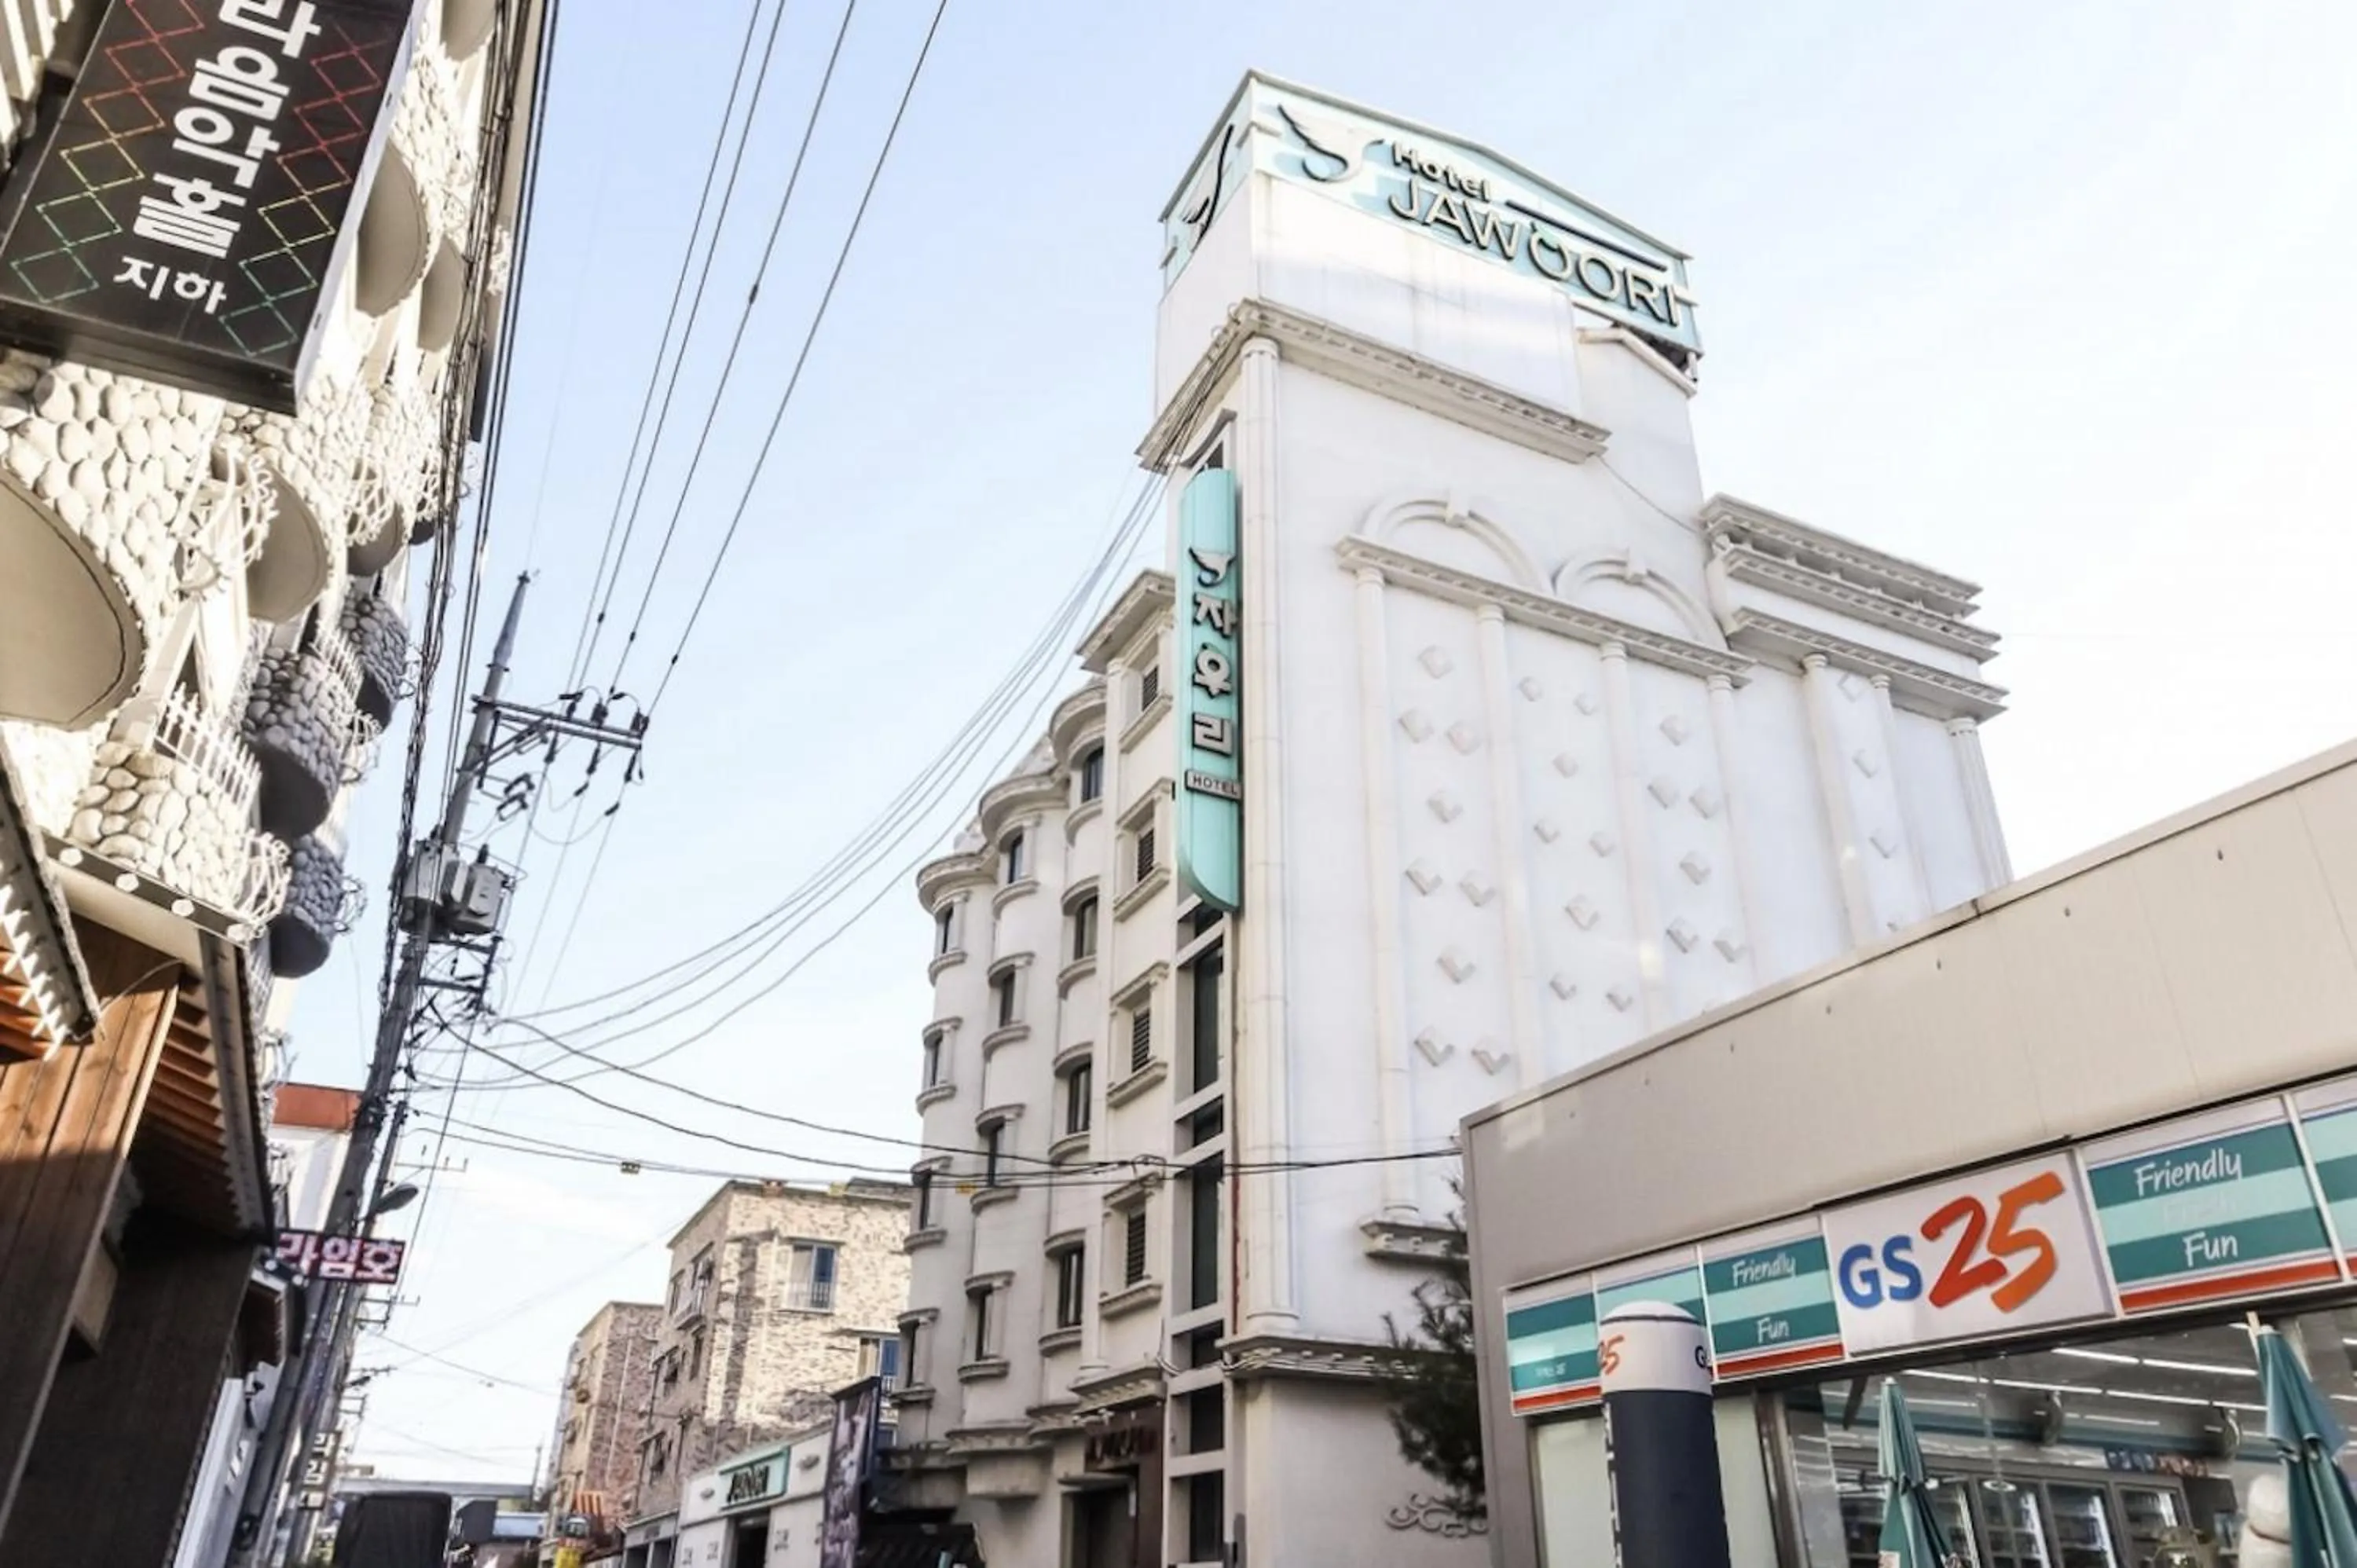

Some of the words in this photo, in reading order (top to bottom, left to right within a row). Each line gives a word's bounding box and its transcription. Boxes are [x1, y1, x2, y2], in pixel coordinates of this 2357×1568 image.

[1391, 141, 1491, 203] Hotel
[1388, 178, 1680, 327] JAWOORI
[112, 256, 227, 314] 지하
[1192, 592, 1239, 757] 자우리
[1193, 772, 1238, 796] HOTEL
[2134, 1148, 2244, 1197] Friendly
[1838, 1170, 2066, 1314] GS25
[2183, 1231, 2238, 1268] Fun
[1732, 1251, 1797, 1288] Friendly
[1756, 1316, 1790, 1343] Fun
